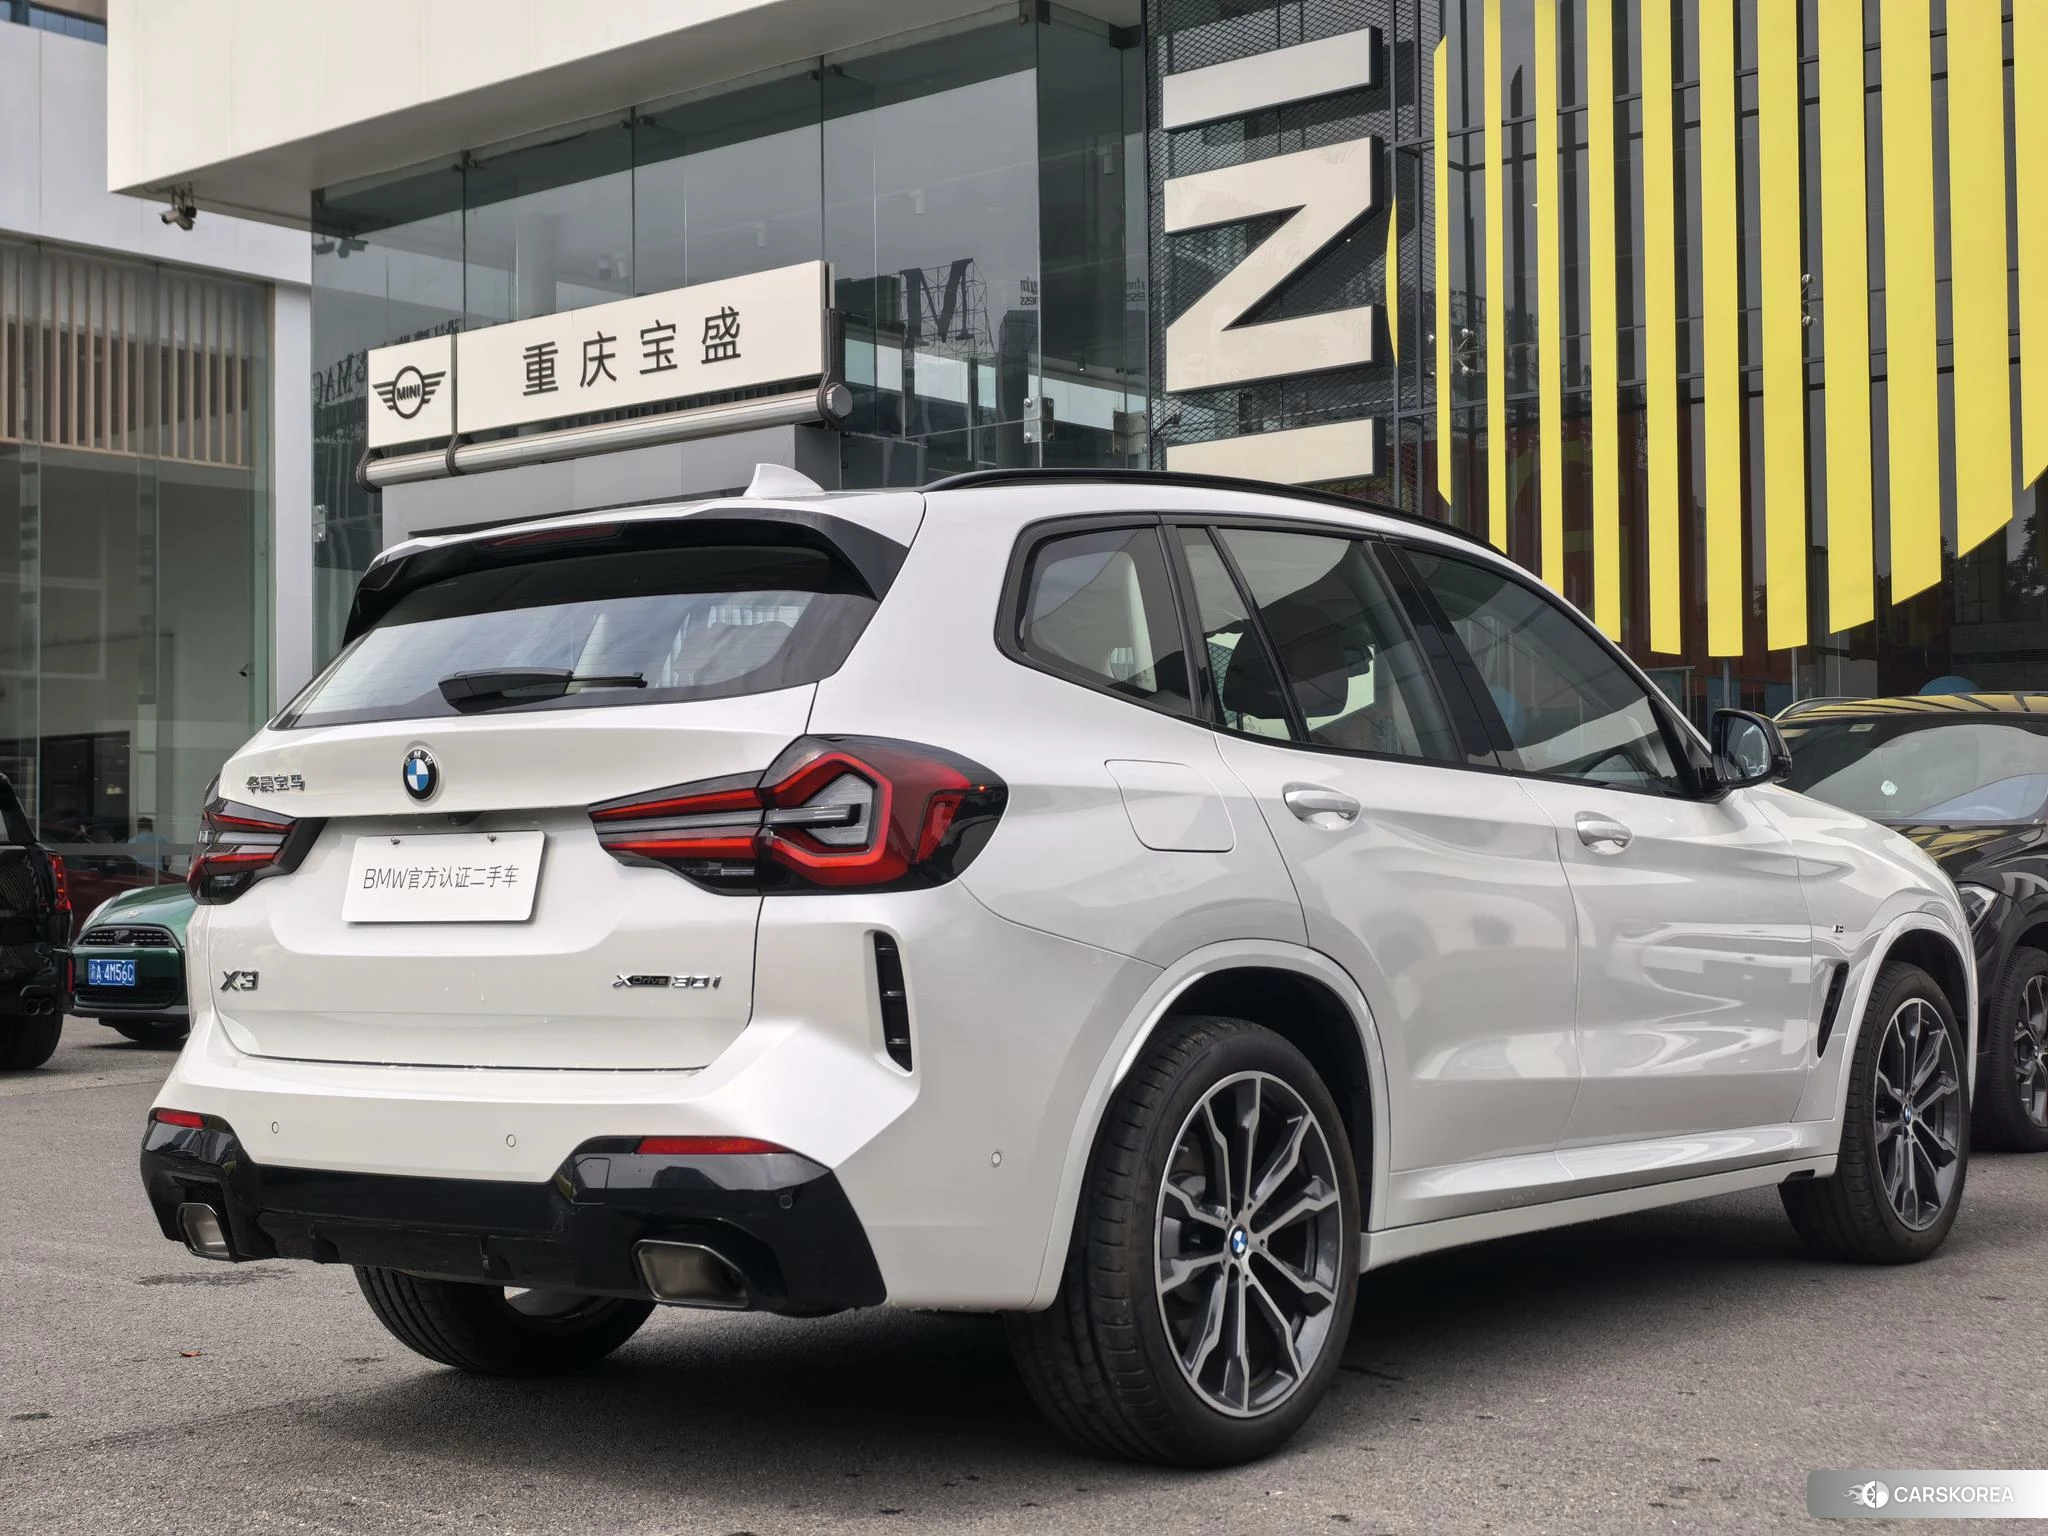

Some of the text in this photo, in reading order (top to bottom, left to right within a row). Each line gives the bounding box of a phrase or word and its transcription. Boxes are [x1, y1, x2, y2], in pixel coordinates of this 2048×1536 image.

[522, 305, 742, 397] 重庆宝盛
[396, 383, 422, 400] MINI
[246, 773, 306, 794] 华晨宝马
[363, 865, 519, 890] BMW官方认证二手车
[220, 970, 260, 992] X3
